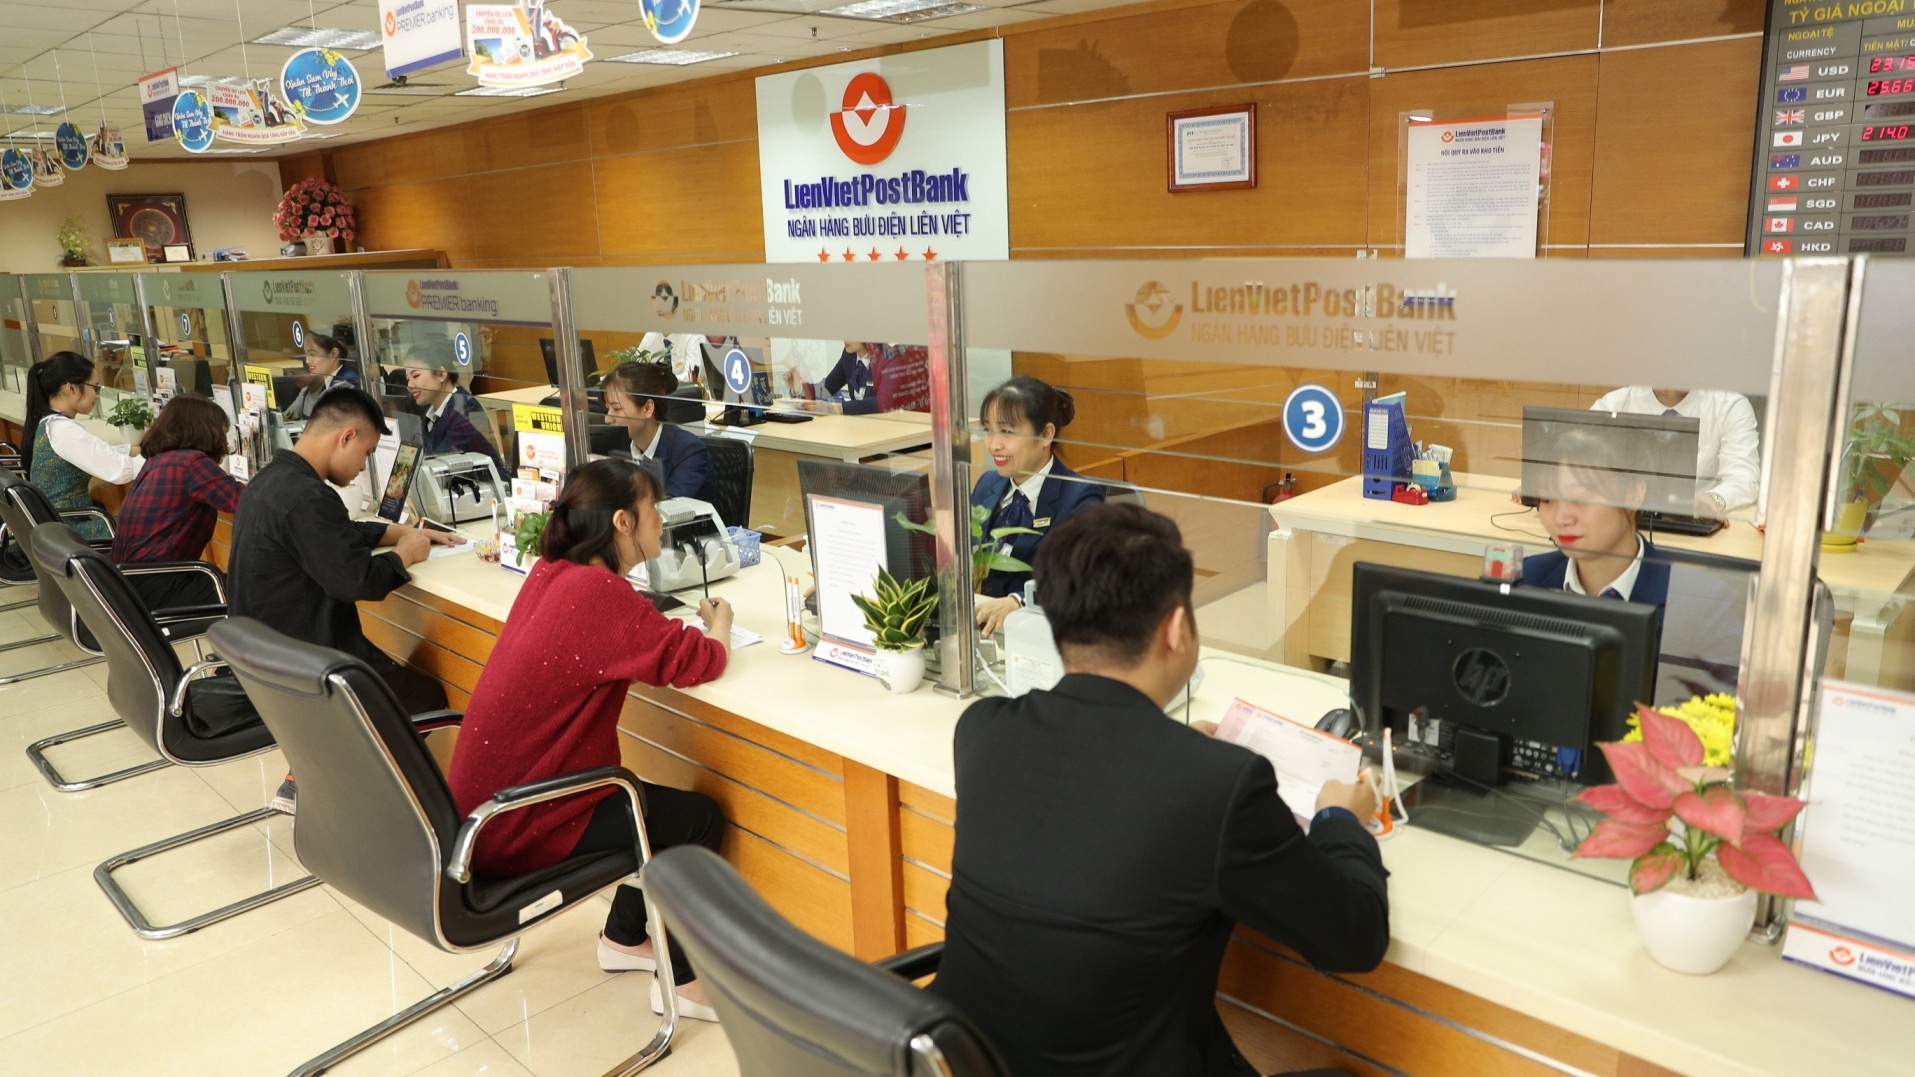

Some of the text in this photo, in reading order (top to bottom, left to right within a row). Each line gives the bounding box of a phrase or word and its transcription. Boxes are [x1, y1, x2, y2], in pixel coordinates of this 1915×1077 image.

[1789, 0, 1905, 24] TỶ GIÁ NGOẠI
[397, 5, 454, 34] PREMIER banking
[1897, 18, 1915, 29] MU
[472, 25, 516, 34] 200.000.000
[1788, 27, 1834, 41] NGOẠI TỆ
[1786, 46, 1836, 59] CURRENCY
[1818, 65, 1849, 76] USD
[1816, 88, 1845, 99] EUR
[211, 95, 250, 108] 200.000.000
[1814, 110, 1844, 121] GBP
[1455, 128, 1506, 138] LienVietPostBank
[1812, 133, 1840, 144] JPY
[1462, 148, 1469, 156] RA
[1470, 147, 1480, 155] VÀO
[1481, 147, 1492, 155] KHO
[1810, 155, 1843, 166] AUD
[783, 167, 969, 209] LienVietPostBank
[1807, 177, 1836, 188] CHF
[1806, 199, 1836, 208] SGD
[787, 209, 971, 239] NGÂN HÀNG BƯU ĐIỆN LIÊN VIỆT
[1803, 221, 1834, 230] CAD
[1801, 242, 1831, 252] HKD
[421, 294, 498, 317] PREMIER banking
[1191, 281, 1458, 321] LienVietPostBank
[784, 306, 802, 328] VIỆT
[294, 326, 302, 343] 6
[1191, 318, 1232, 344] NGÂN
[1238, 321, 1280, 346] HÀNG
[1414, 325, 1457, 355] VIỆT
[459, 340, 467, 360] 5
[731, 359, 745, 385] 4
[531, 411, 562, 424] WESTERN
[1301, 400, 1327, 439] 3
[541, 421, 563, 432] UNION
